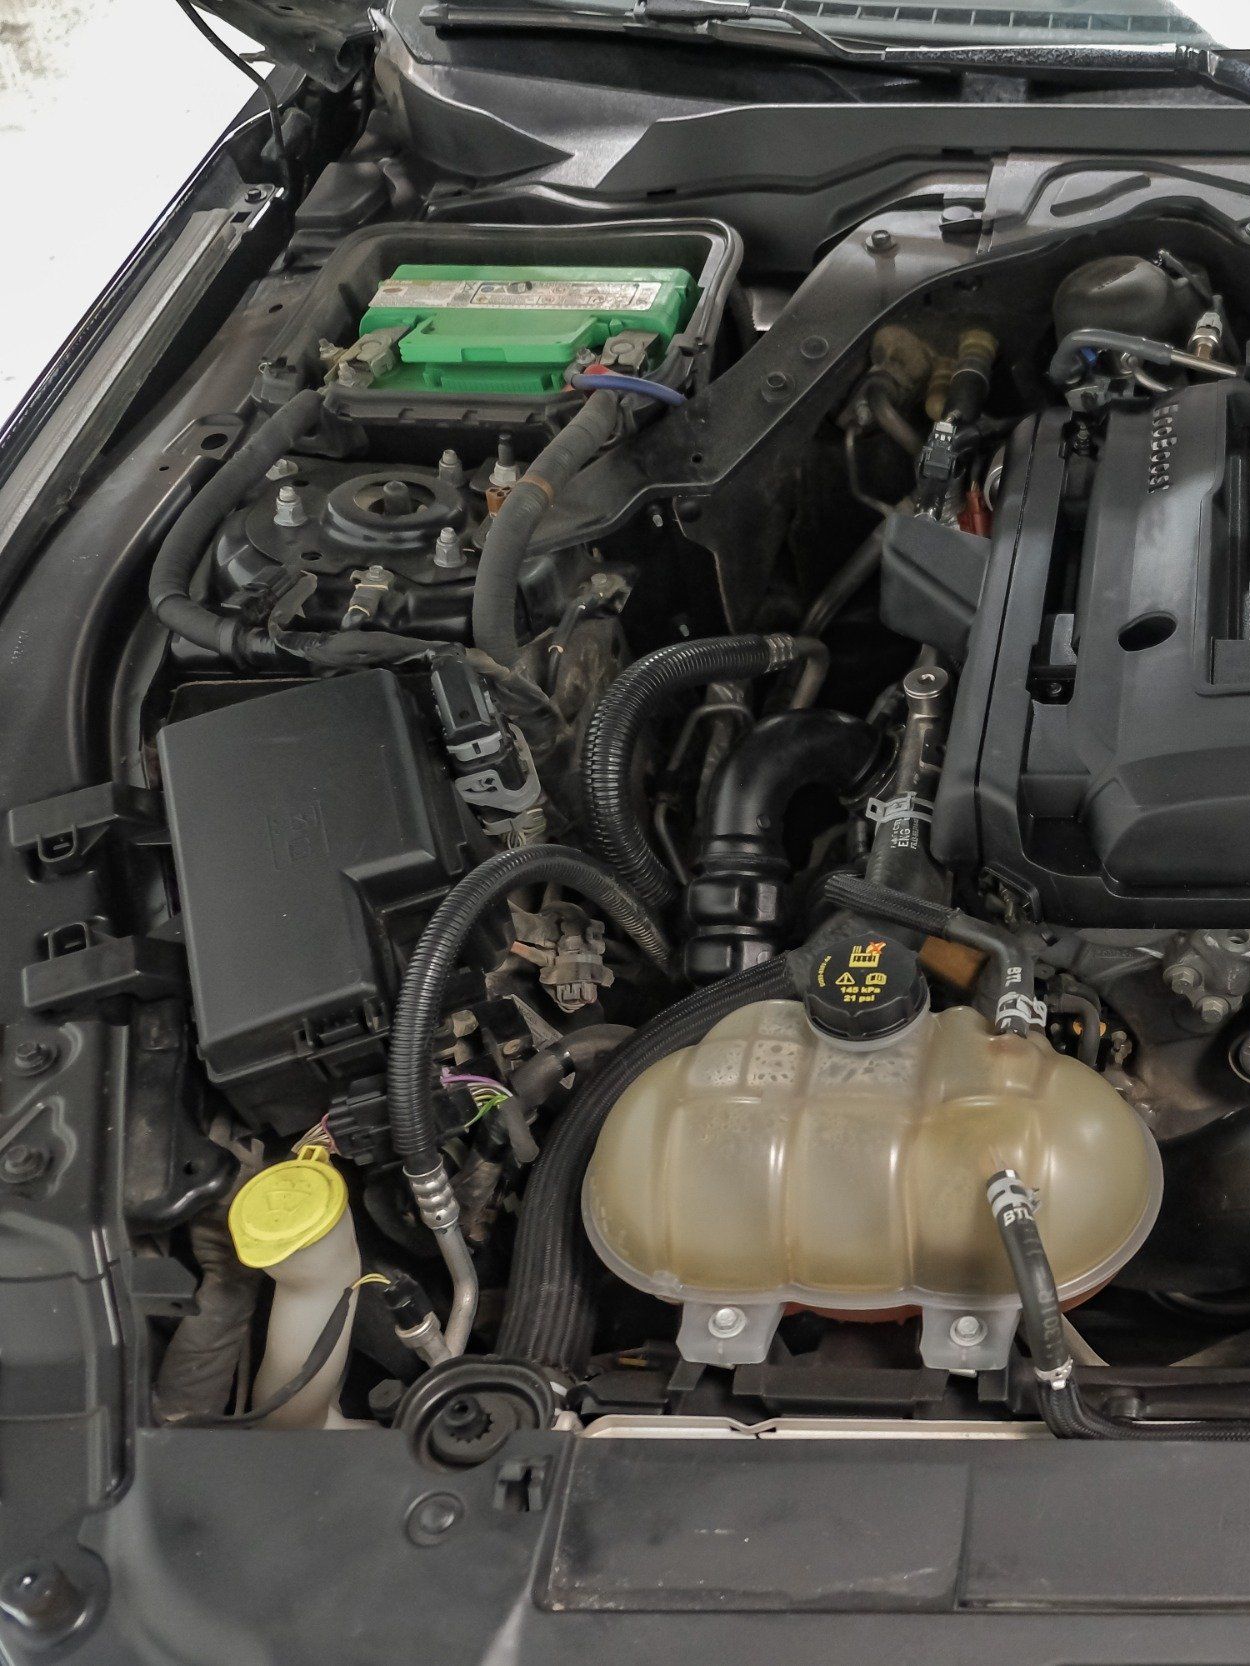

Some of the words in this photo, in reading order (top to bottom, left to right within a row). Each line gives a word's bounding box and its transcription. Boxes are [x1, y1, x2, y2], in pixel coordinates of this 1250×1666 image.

[1148, 404, 1179, 493] EcoBoost
[898, 828, 911, 847] ENG
[841, 986, 859, 994] 145
[861, 986, 880, 994] kPa
[844, 994, 856, 1002] 21
[859, 994, 875, 1003] psi
